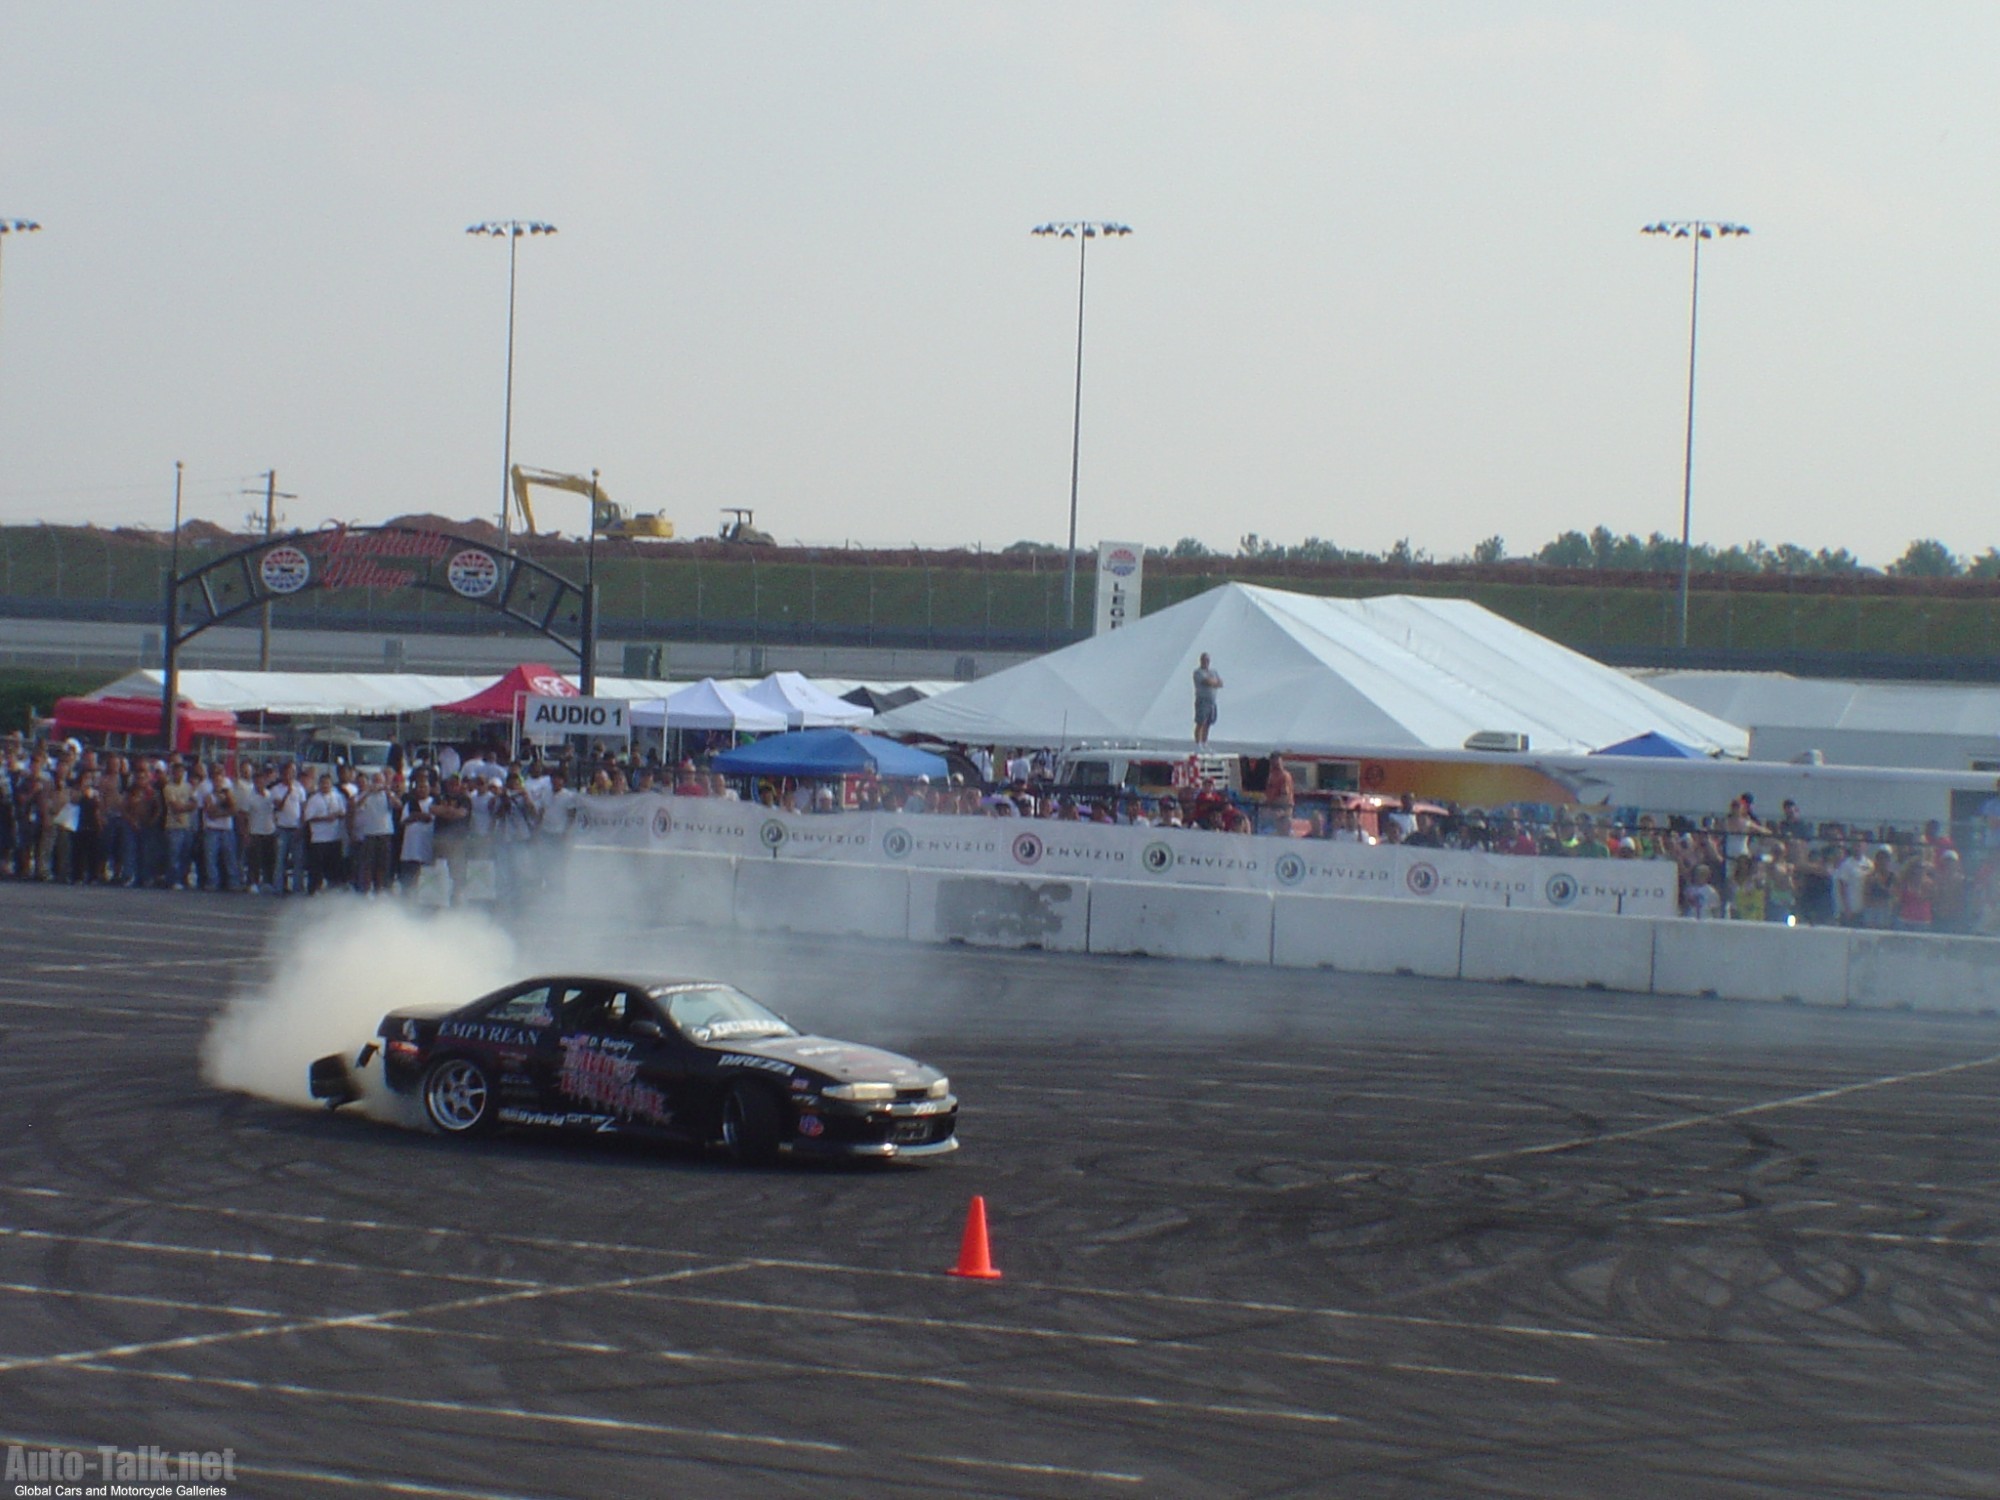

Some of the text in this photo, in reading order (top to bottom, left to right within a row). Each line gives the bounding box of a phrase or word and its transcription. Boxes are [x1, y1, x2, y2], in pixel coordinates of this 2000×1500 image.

[535, 703, 623, 727] AUDIO 1
[672, 822, 745, 838] ENVIZIO
[792, 832, 865, 846] ENVIZIO
[916, 839, 995, 853] ENVIZIO
[1046, 846, 1125, 862] ENVIZIO
[1177, 855, 1258, 871] ENVIZIO
[1309, 865, 1389, 881] ENVIZIO
[1441, 875, 1527, 893] ENVIZIO
[1581, 884, 1665, 898] ENVIZIO
[437, 1020, 543, 1046] EMPYREAN
